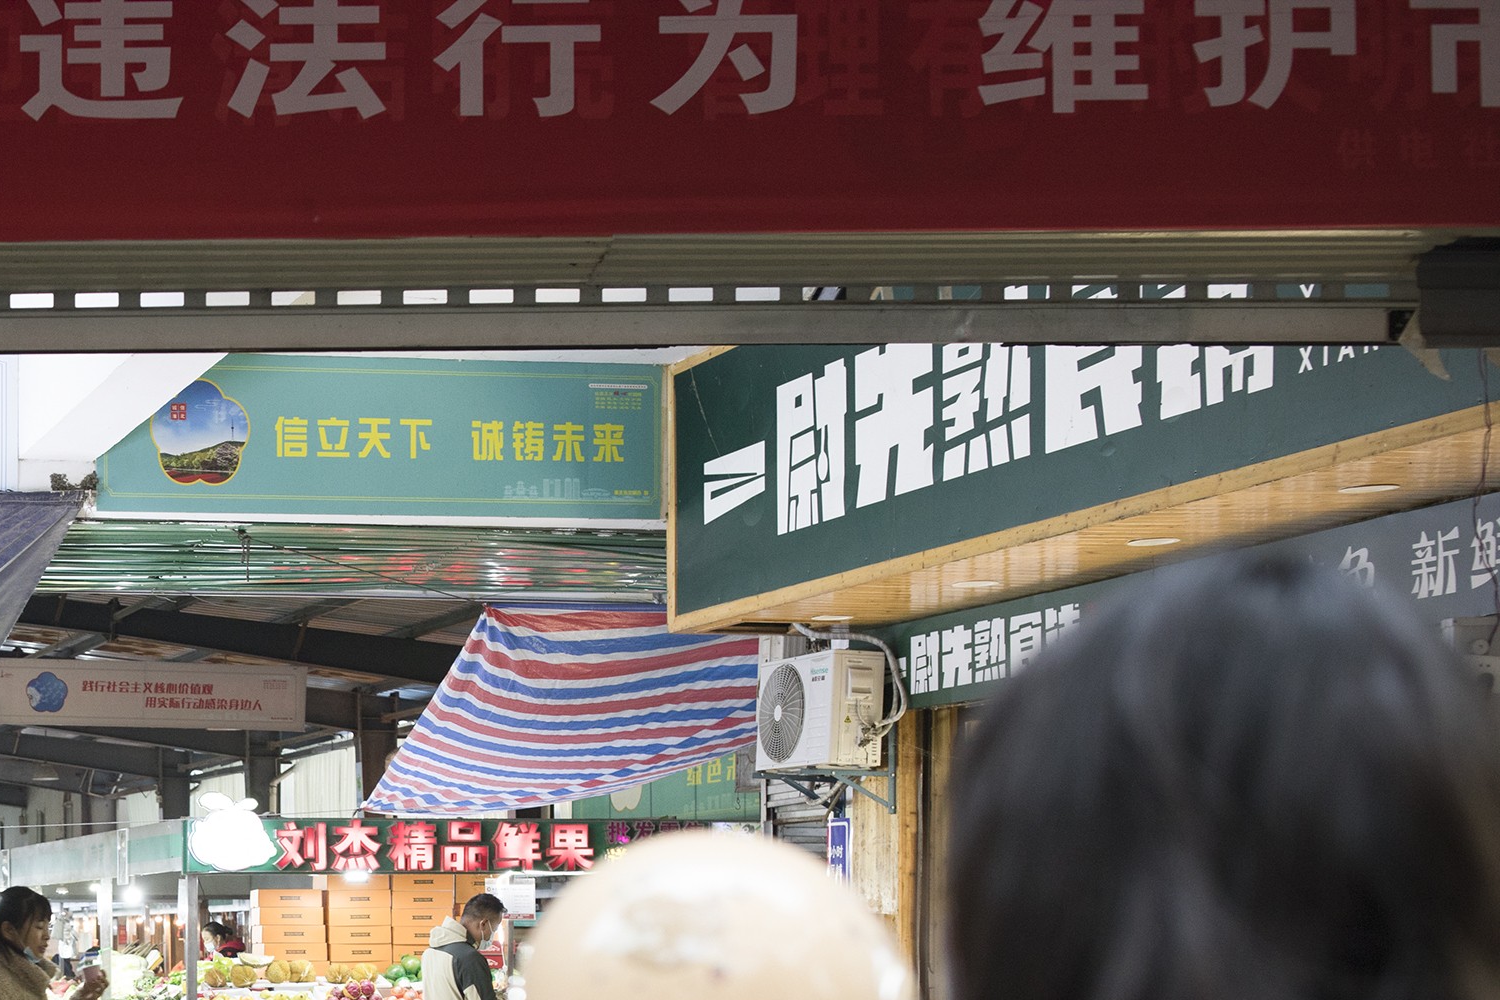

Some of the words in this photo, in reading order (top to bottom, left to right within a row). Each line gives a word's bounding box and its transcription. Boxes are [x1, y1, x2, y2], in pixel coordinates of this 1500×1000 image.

[274, 415, 433, 459] 信立天下
[471, 420, 625, 462] 诚铸未来
[82, 680, 213, 695] 践行社会主义核心价值观
[145, 696, 263, 712] 用实际行动感染身边人
[273, 819, 595, 873] 刘杰精品鲜果
